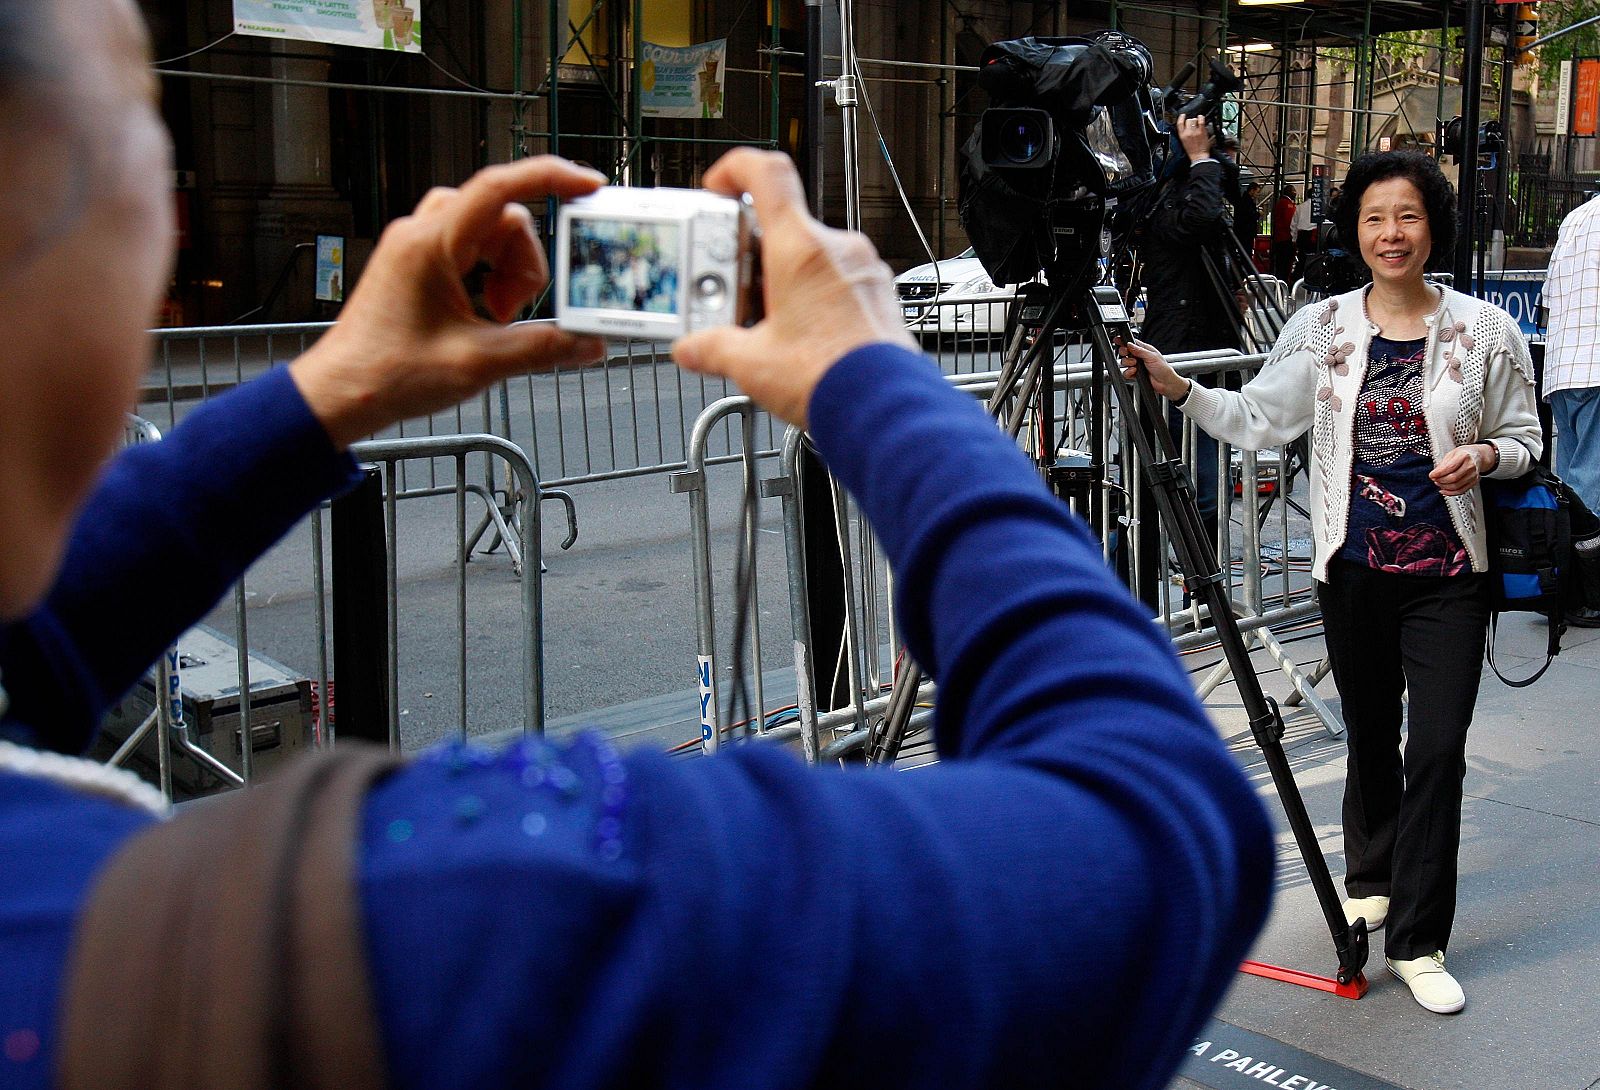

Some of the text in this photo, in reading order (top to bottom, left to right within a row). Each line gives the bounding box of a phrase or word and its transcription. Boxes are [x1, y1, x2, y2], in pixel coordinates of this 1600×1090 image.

[317, 9, 357, 19] SMOOTHIES
[166, 637, 181, 719] YPD
[698, 661, 713, 748] NYP
[1190, 1038, 1213, 1056] A
[1209, 1048, 1338, 1090] PAHLEV
